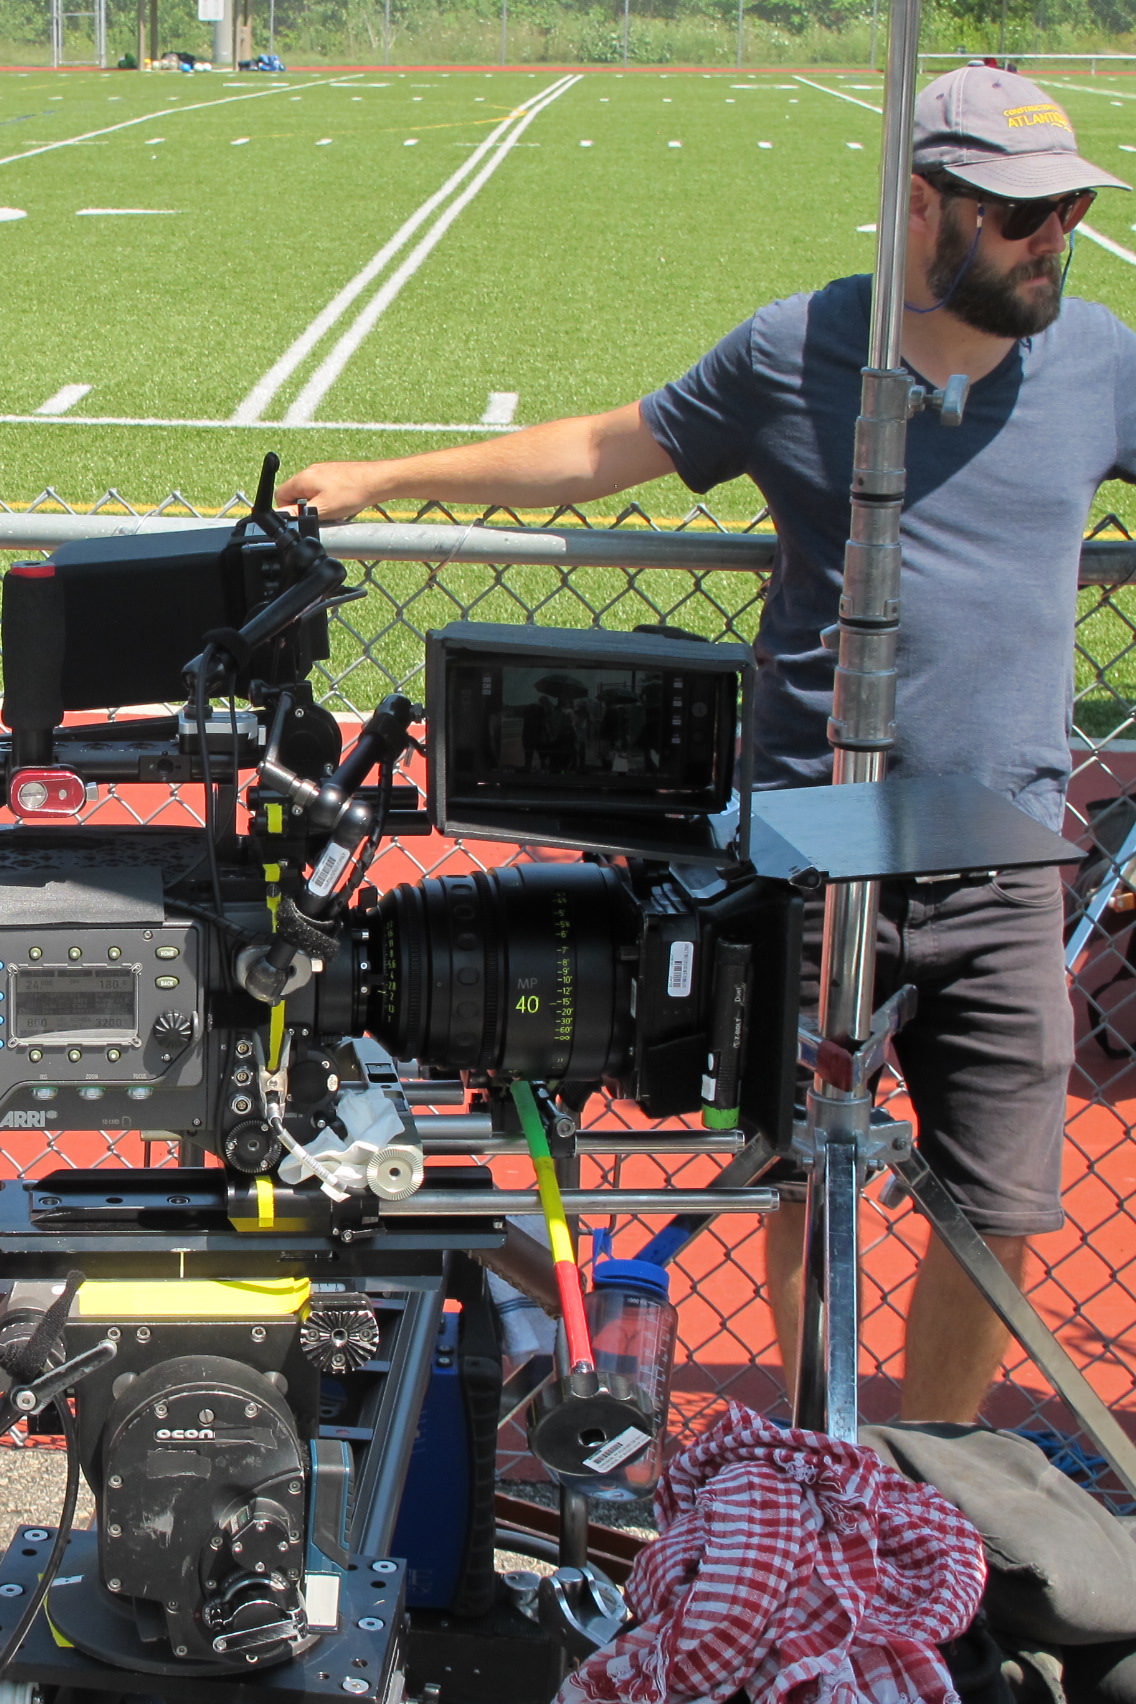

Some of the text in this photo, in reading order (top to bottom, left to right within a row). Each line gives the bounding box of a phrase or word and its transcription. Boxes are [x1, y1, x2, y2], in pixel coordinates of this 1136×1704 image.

[517, 977, 538, 989] MP
[515, 995, 540, 1014] 40
[156, 1429, 216, 1439] ocon
